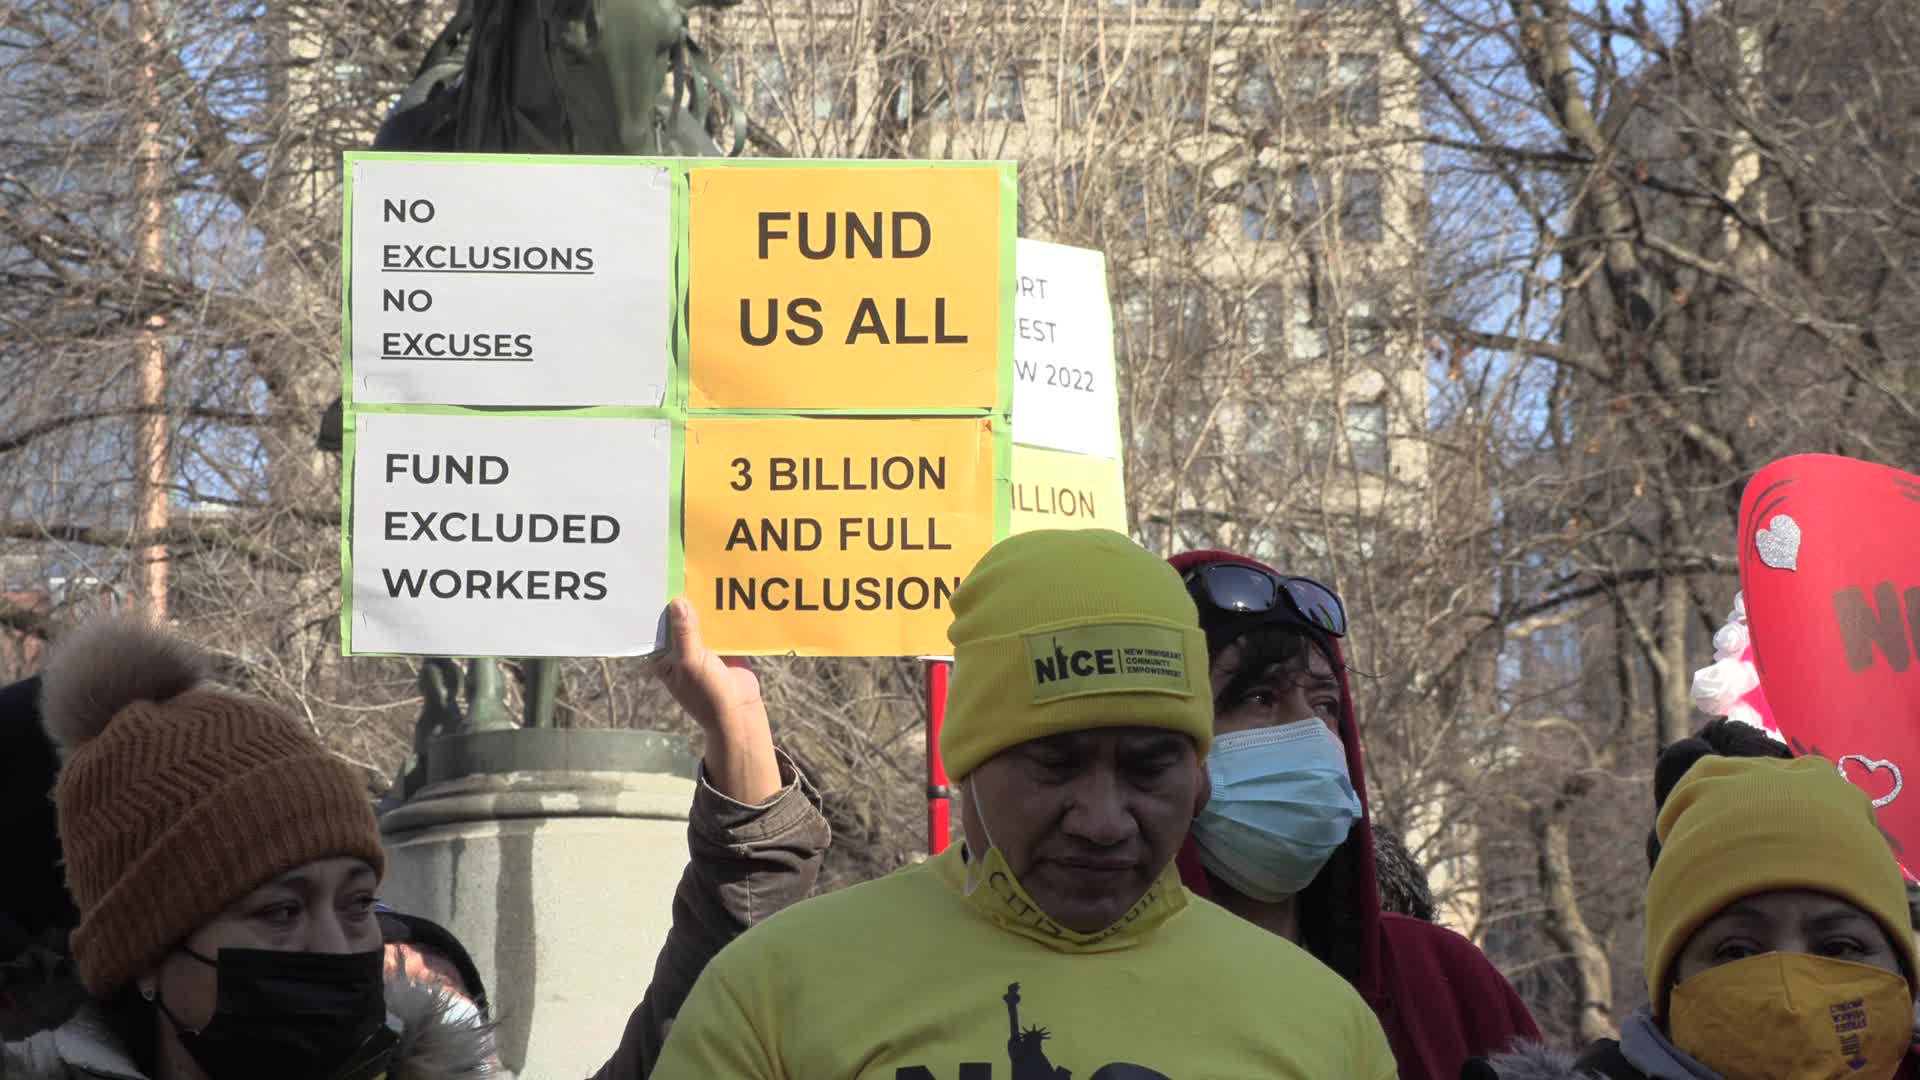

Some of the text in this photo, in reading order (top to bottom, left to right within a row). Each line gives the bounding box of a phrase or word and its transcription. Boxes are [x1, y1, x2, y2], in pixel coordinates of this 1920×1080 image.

[383, 199, 435, 223] NO
[758, 211, 931, 260] FUND
[382, 245, 594, 271] EXCLUSIONS
[382, 289, 432, 312] NO
[1015, 276, 1048, 299] RT
[740, 297, 968, 346] US ALL
[1015, 318, 1056, 343] EST
[382, 333, 533, 358] EXCUSES
[1045, 364, 1095, 393] 2022
[385, 453, 509, 485] FUND
[730, 456, 945, 491] 3 BILLION
[384, 511, 621, 544] EXCLUDED
[725, 517, 952, 551] AND FULL
[382, 568, 608, 600] WORKERS
[715, 577, 960, 611] INCLUSION
